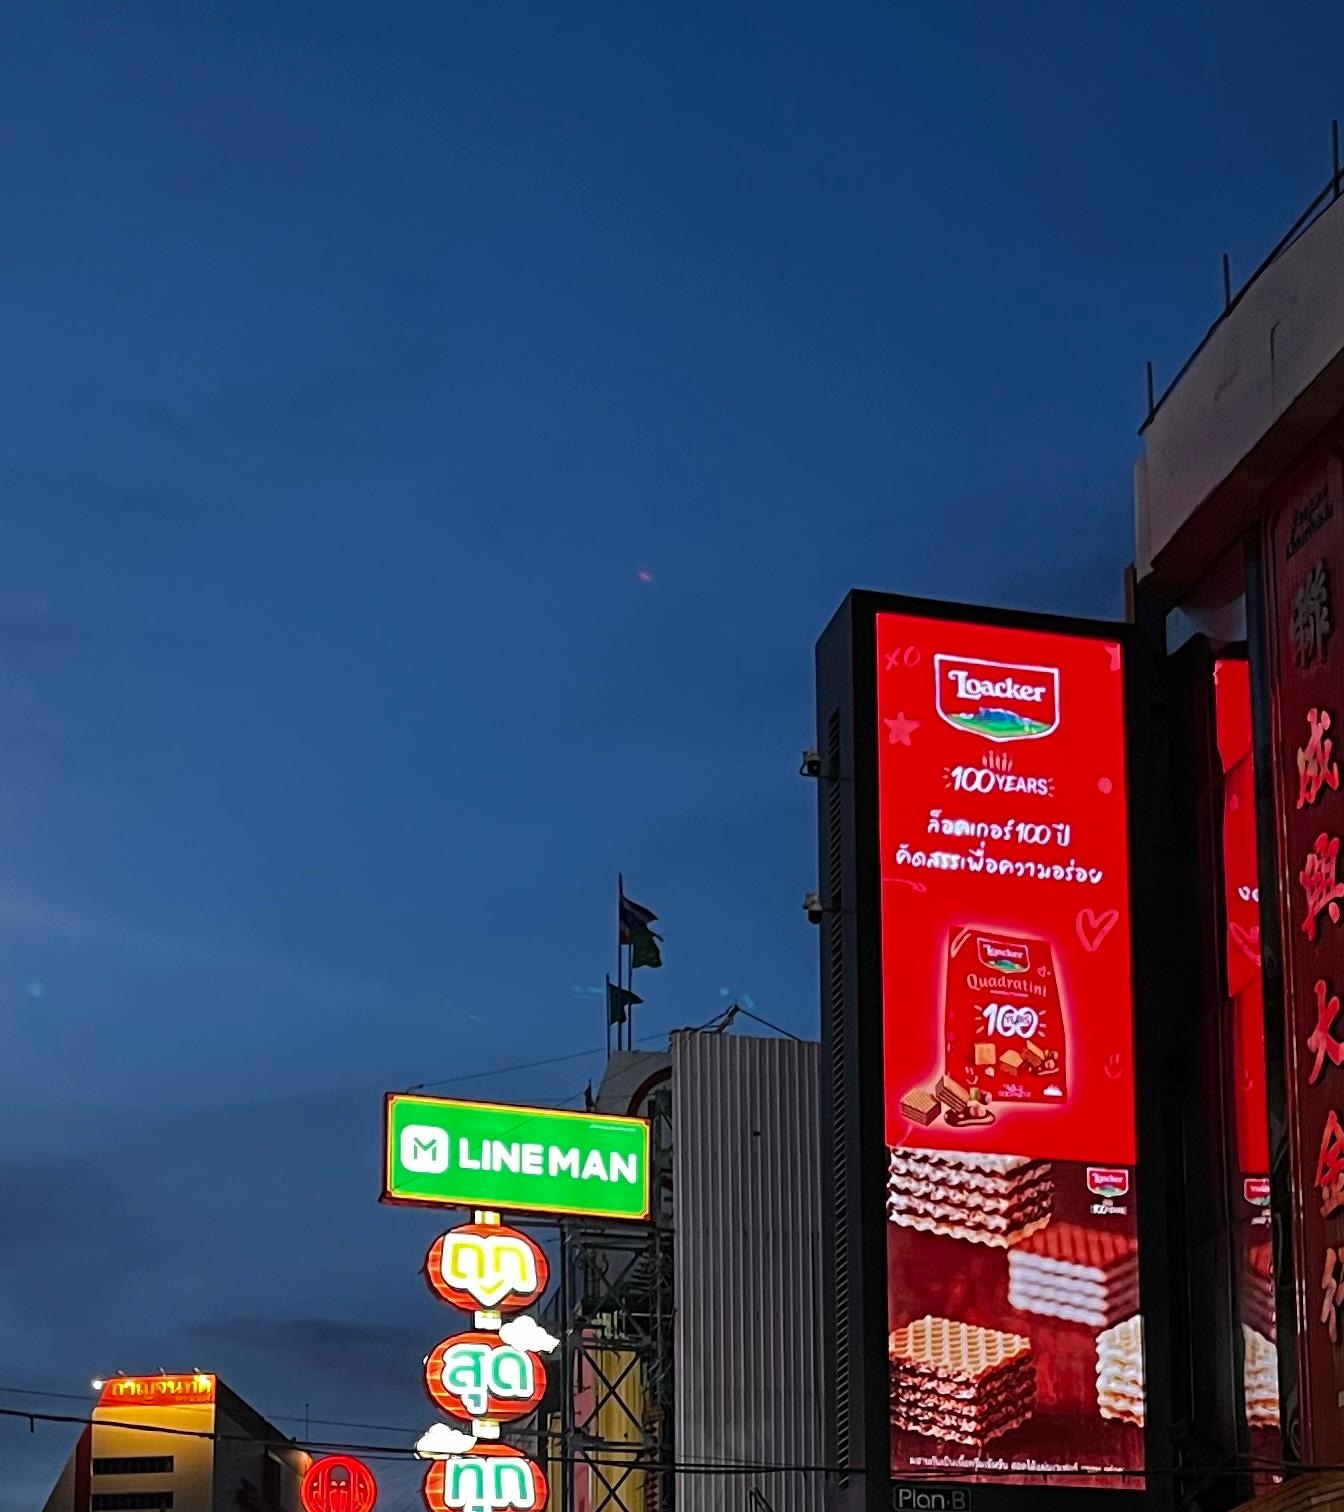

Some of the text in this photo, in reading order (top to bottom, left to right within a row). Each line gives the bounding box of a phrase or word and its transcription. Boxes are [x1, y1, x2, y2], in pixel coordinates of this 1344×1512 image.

[947, 669, 1047, 703] Loacker
[950, 766, 1049, 796] 100 YEARS
[966, 973, 1047, 998] Quadratini
[982, 1003, 1038, 1039] 100
[459, 1136, 637, 1184] LINE MAN
[447, 1342, 531, 1413] สุด
